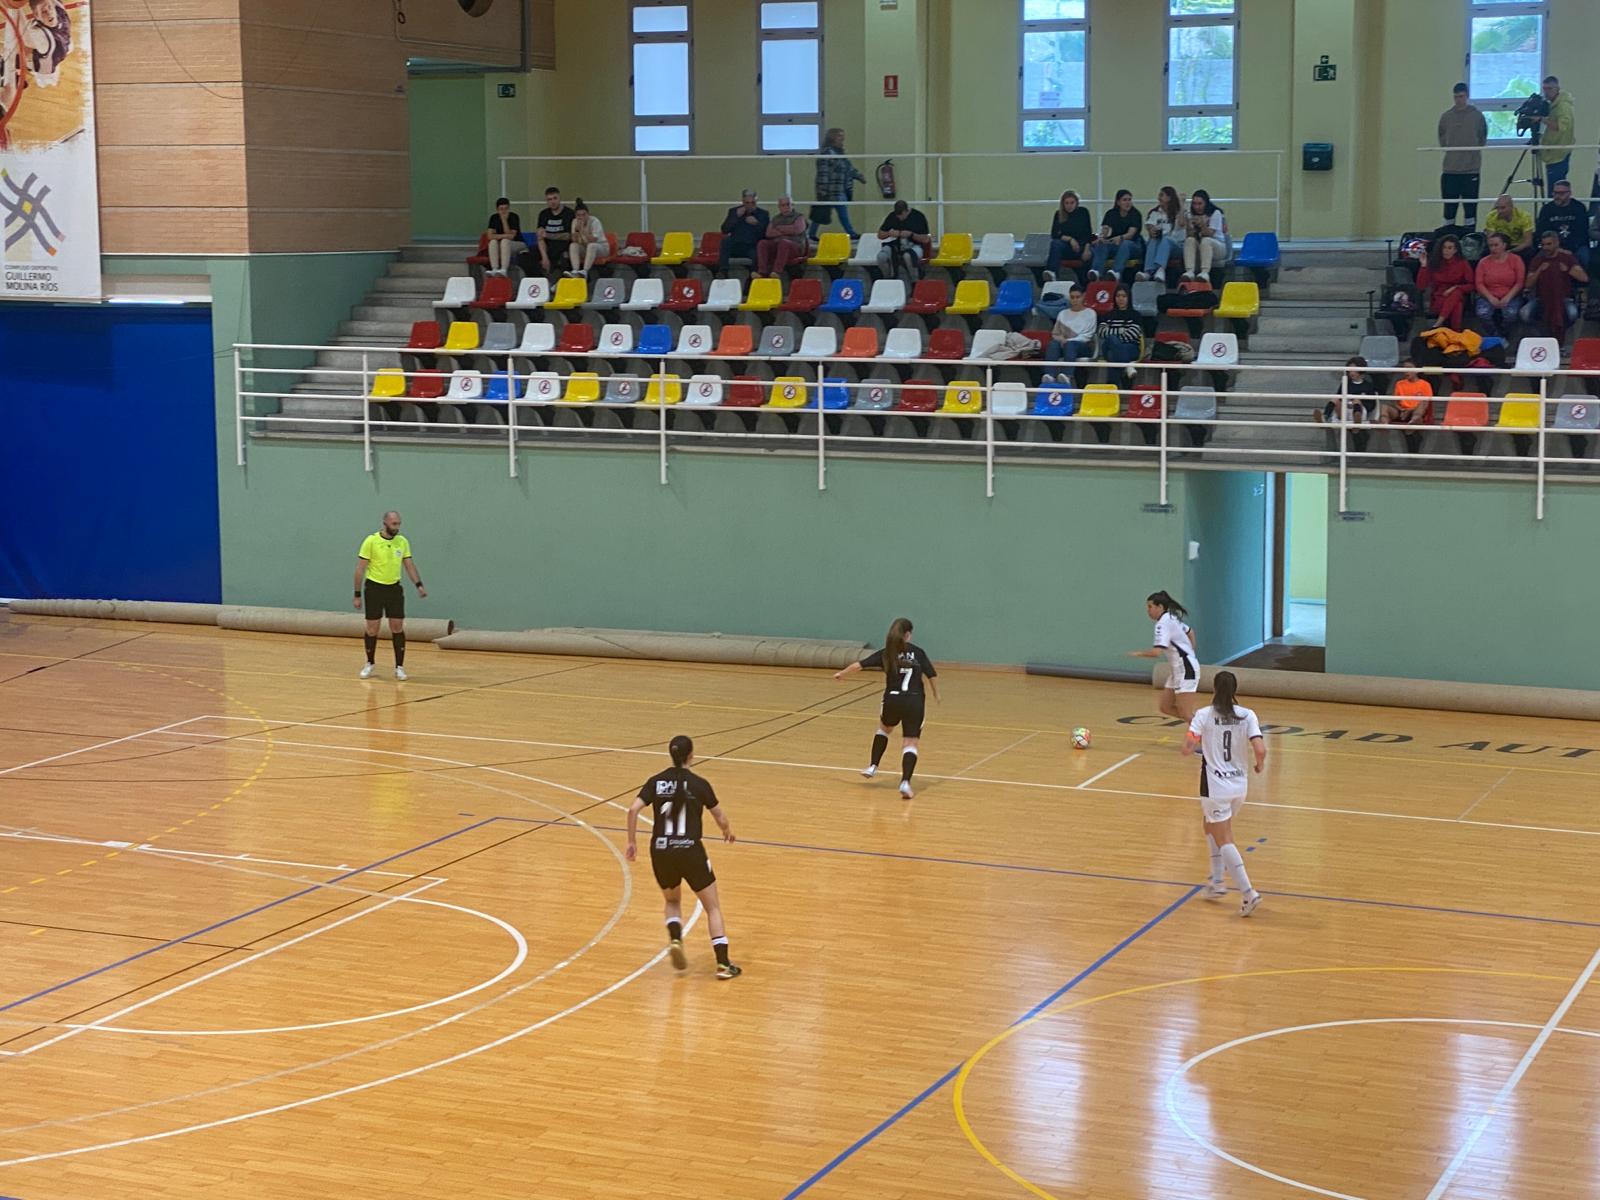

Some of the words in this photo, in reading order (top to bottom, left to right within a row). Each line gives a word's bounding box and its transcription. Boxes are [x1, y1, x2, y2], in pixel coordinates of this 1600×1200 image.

[5, 271, 52, 281] GUILLERMO
[6, 281, 38, 291] MOLINA
[899, 667, 913, 691] 7
[1116, 715, 1413, 743] CIDAD
[1222, 730, 1232, 762] 9
[660, 801, 687, 836] 11
